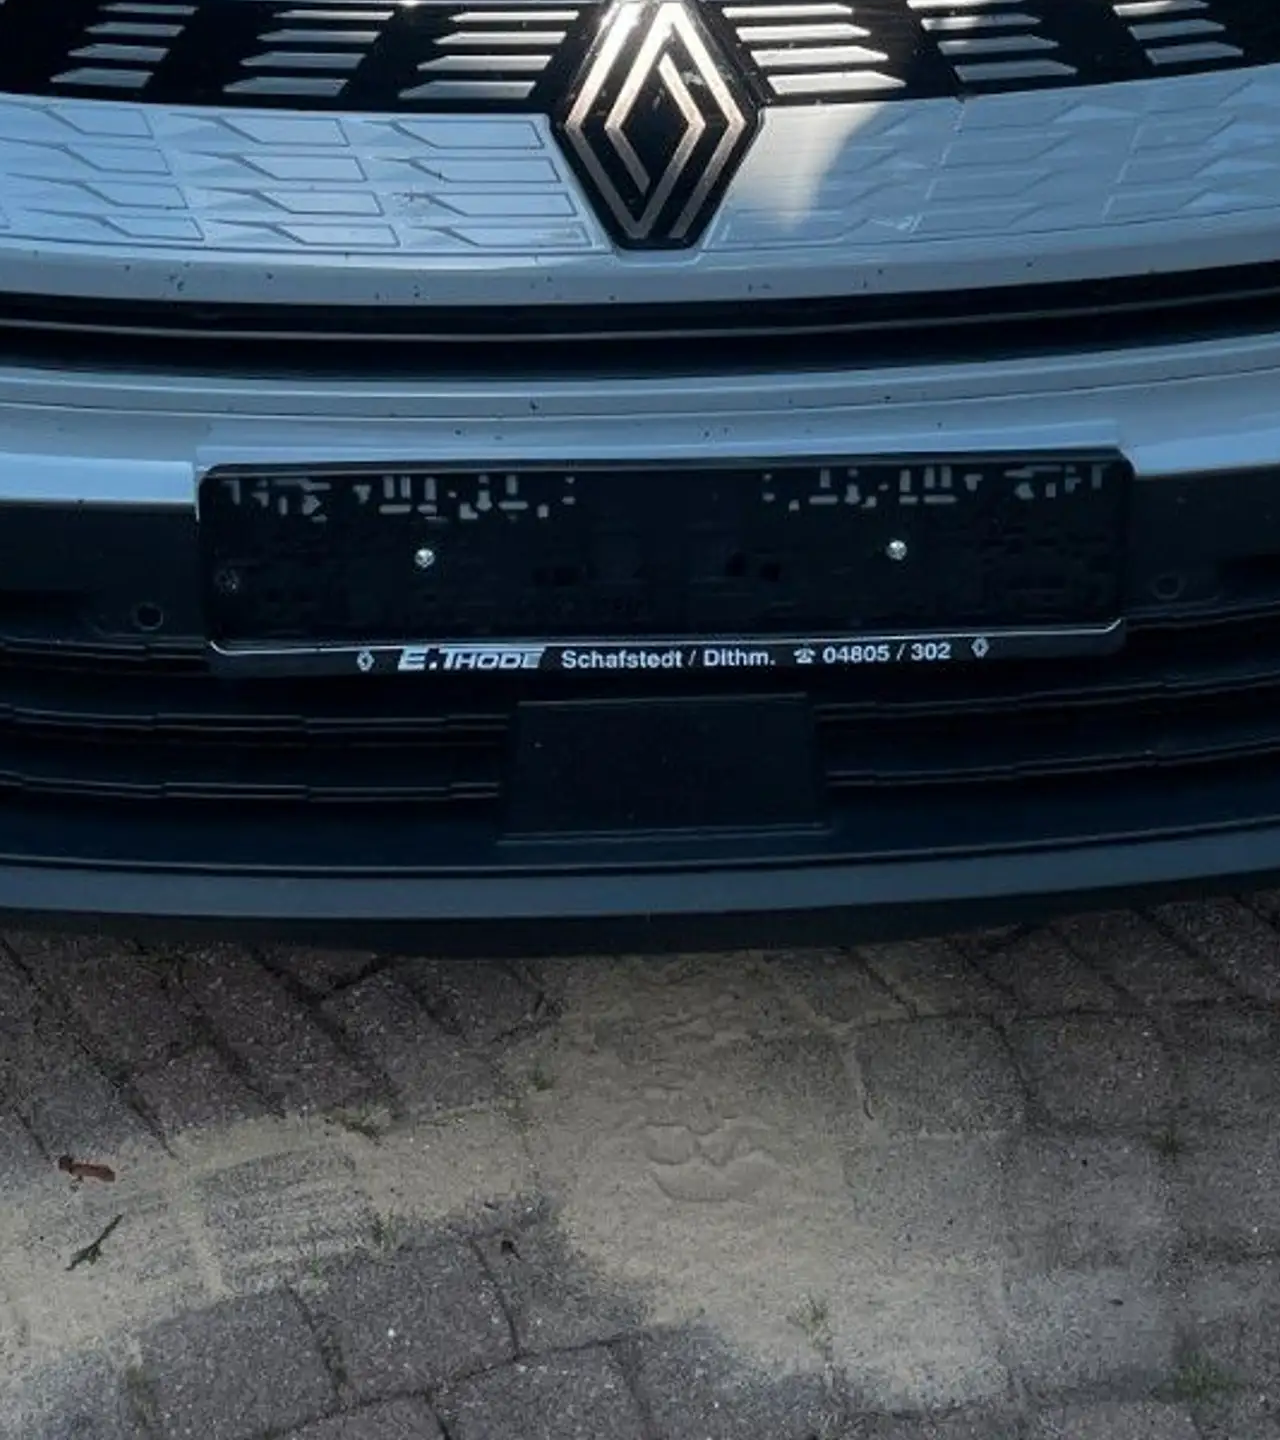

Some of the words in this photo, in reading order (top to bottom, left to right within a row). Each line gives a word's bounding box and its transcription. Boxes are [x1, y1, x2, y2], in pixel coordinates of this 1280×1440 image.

[561, 649, 682, 668] Schafstedt
[703, 648, 776, 666] Dithm.
[822, 645, 890, 663] 04805
[910, 642, 951, 661] 302
